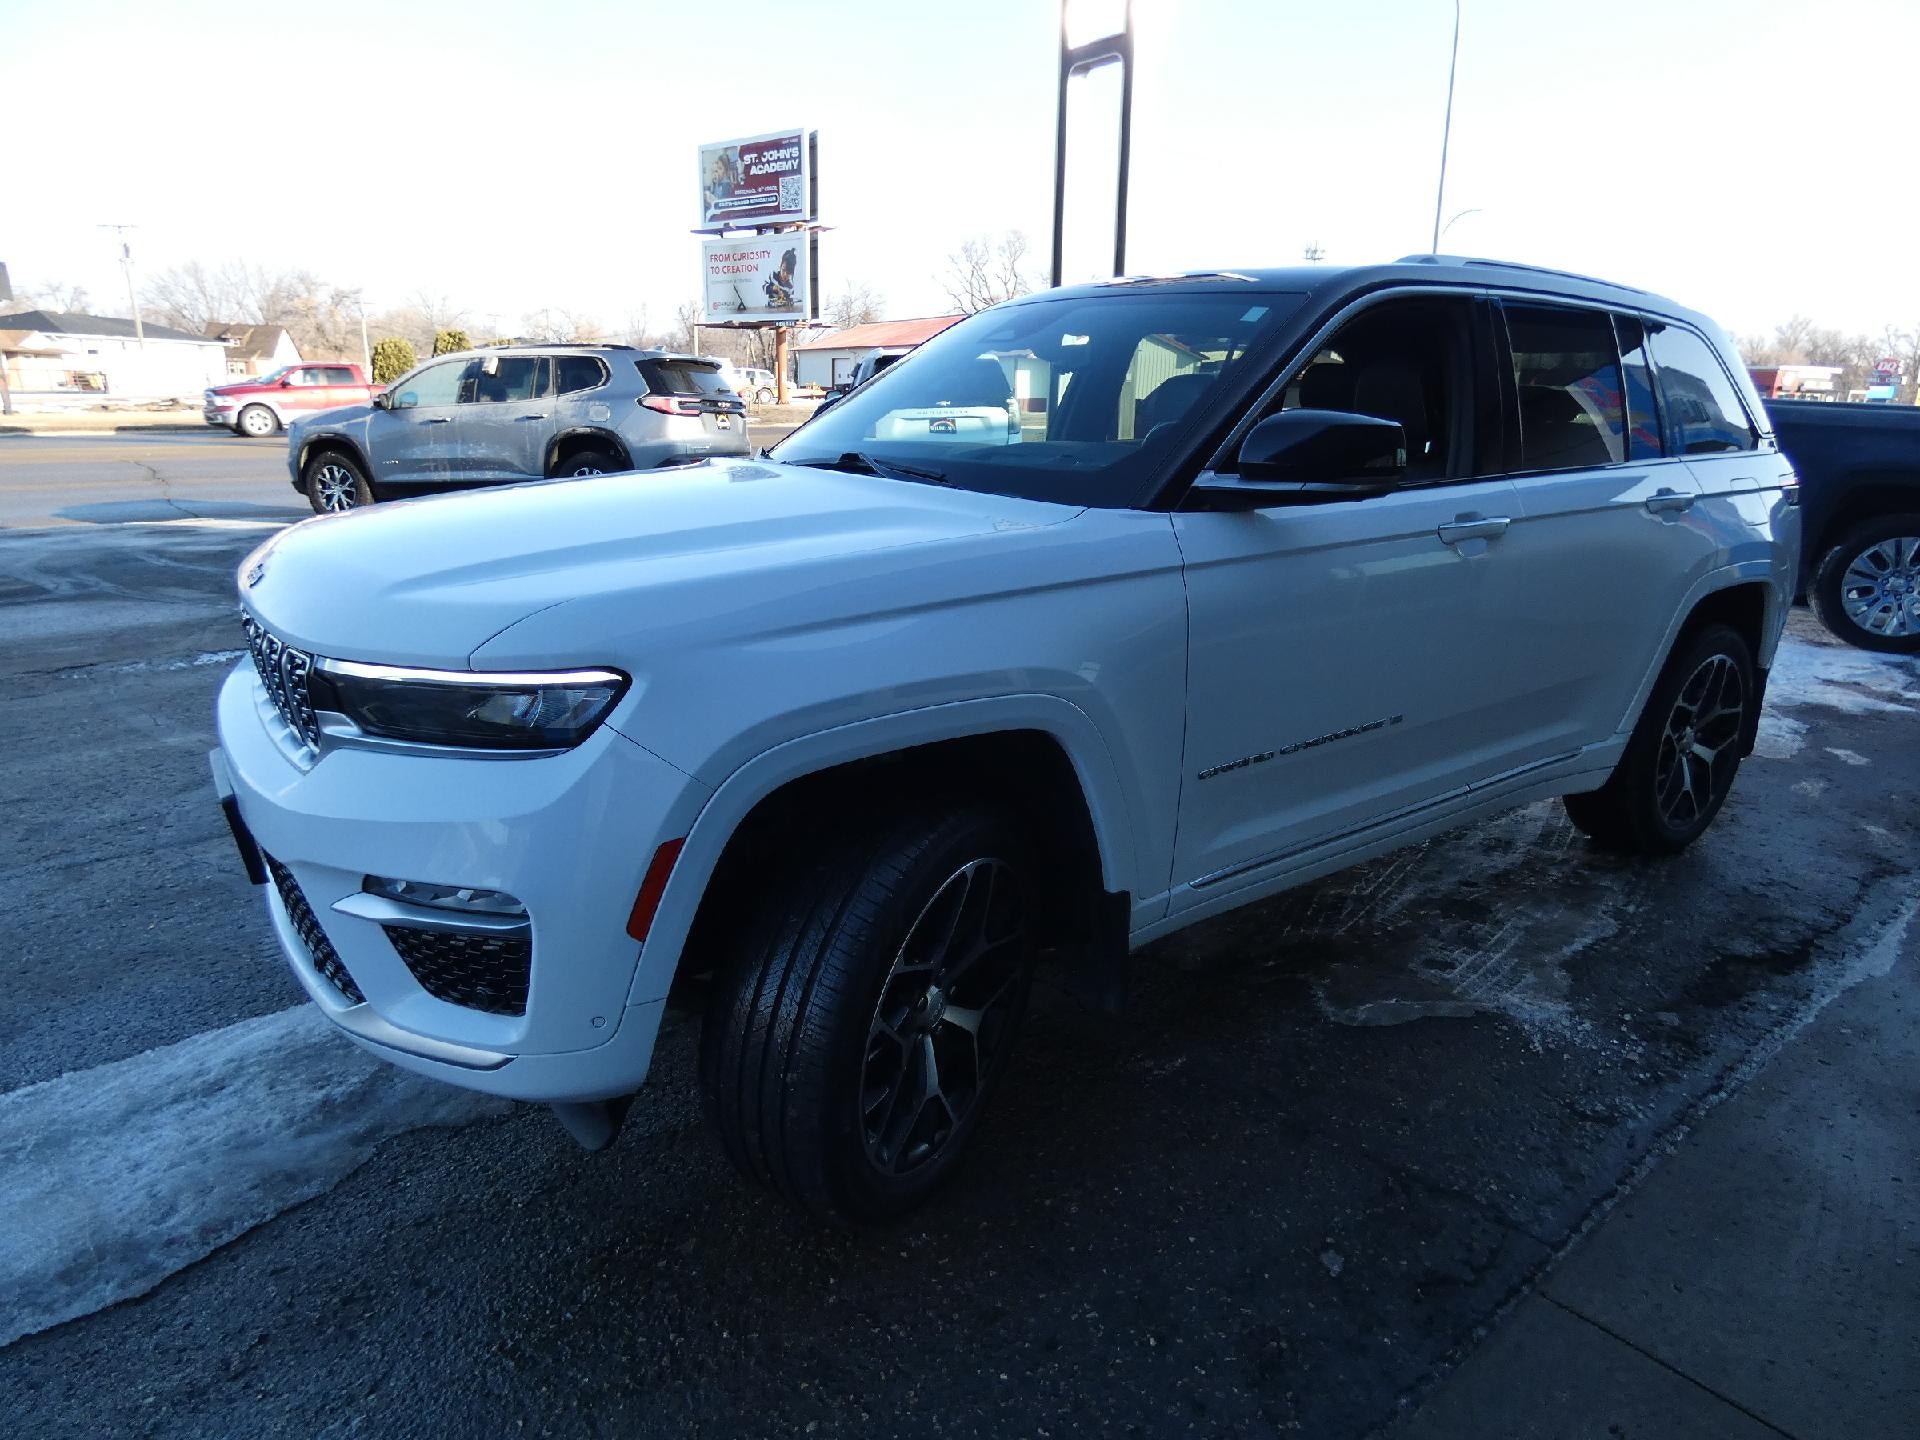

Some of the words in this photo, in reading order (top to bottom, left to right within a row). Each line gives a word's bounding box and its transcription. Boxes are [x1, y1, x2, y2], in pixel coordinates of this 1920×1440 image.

[743, 153, 759, 164] ST.
[761, 147, 799, 163] JOHN'S
[750, 159, 799, 175] ACADEMY
[710, 252, 731, 262] FROM
[732, 250, 771, 262] CURIOSITY
[710, 266, 720, 275] TO
[721, 264, 759, 274] CREATION
